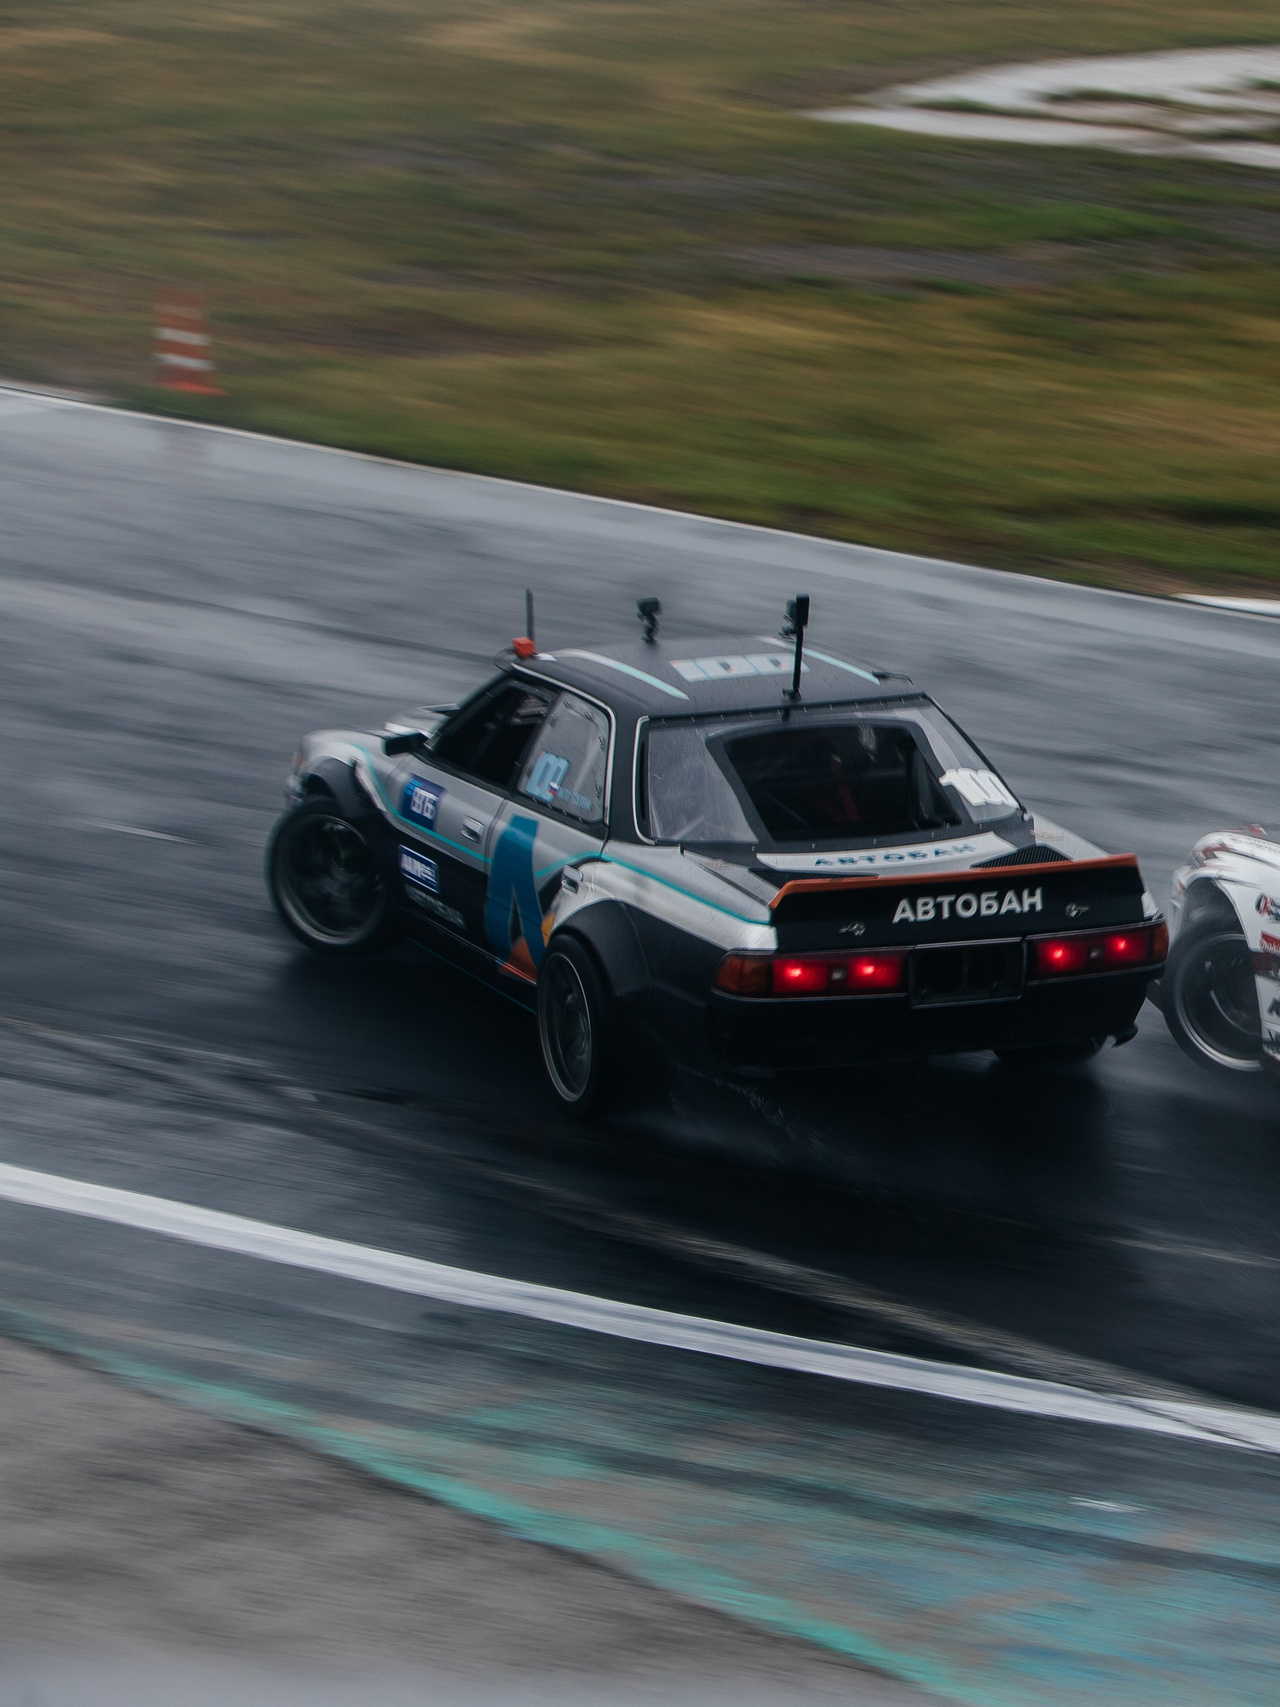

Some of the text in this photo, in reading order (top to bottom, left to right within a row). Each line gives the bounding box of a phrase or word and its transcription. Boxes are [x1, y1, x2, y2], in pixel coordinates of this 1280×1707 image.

[938, 767, 1020, 807] 100
[814, 842, 978, 867] АВТОБАН
[891, 886, 1043, 925] АВТОБАН
